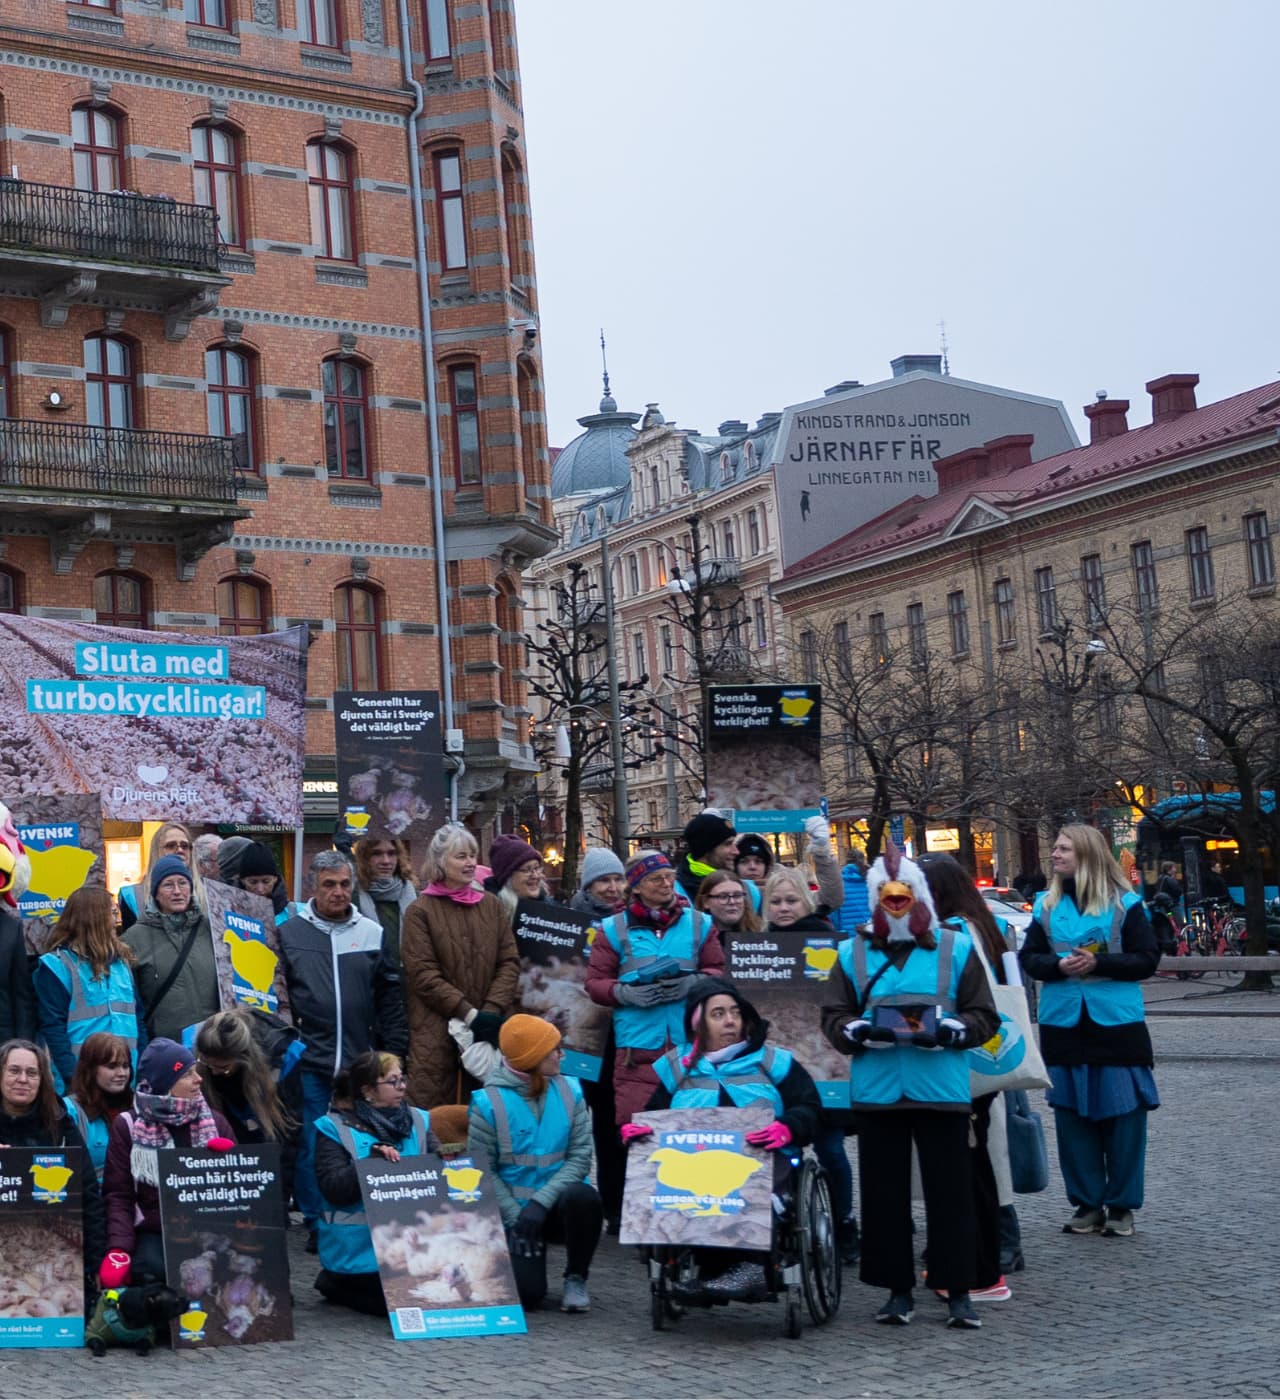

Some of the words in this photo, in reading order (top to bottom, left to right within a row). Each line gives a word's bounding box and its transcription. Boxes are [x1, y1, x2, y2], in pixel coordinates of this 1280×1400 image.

[790, 434, 940, 462] JÄRNAFFÄR
[808, 471, 902, 486] LINNEGATAN
[82, 646, 156, 674] Sluta
[166, 646, 223, 676] med
[32, 684, 262, 720] turbokycklingar!
[404, 697, 421, 706] har
[714, 693, 756, 702] Svenska
[340, 710, 373, 721] djuren
[375, 710, 392, 719] här
[399, 710, 434, 720] Sverige
[714, 705, 772, 716] kycklingars
[350, 722, 367, 732] det
[368, 722, 402, 733] väldigt
[714, 717, 769, 728] verklighet!
[114, 787, 168, 804] Djurens
[170, 786, 203, 802] Rätt.
[20, 827, 74, 840] SVENSK
[228, 916, 262, 934] SVENSK
[520, 913, 582, 934] Systematiskt
[732, 941, 778, 951] Svenska
[732, 954, 795, 967] kycklingars
[732, 968, 791, 981] verklighet!
[666, 1134, 734, 1144] SVENSK
[239, 1154, 259, 1165] har
[166, 1174, 204, 1187] djuren
[206, 1172, 226, 1184] här
[233, 1170, 274, 1184] Sverige
[367, 1170, 437, 1186] Systematiskt
[178, 1190, 198, 1202] det
[199, 1188, 238, 1201] väldigt
[370, 1186, 436, 1201] djurplågeri!
